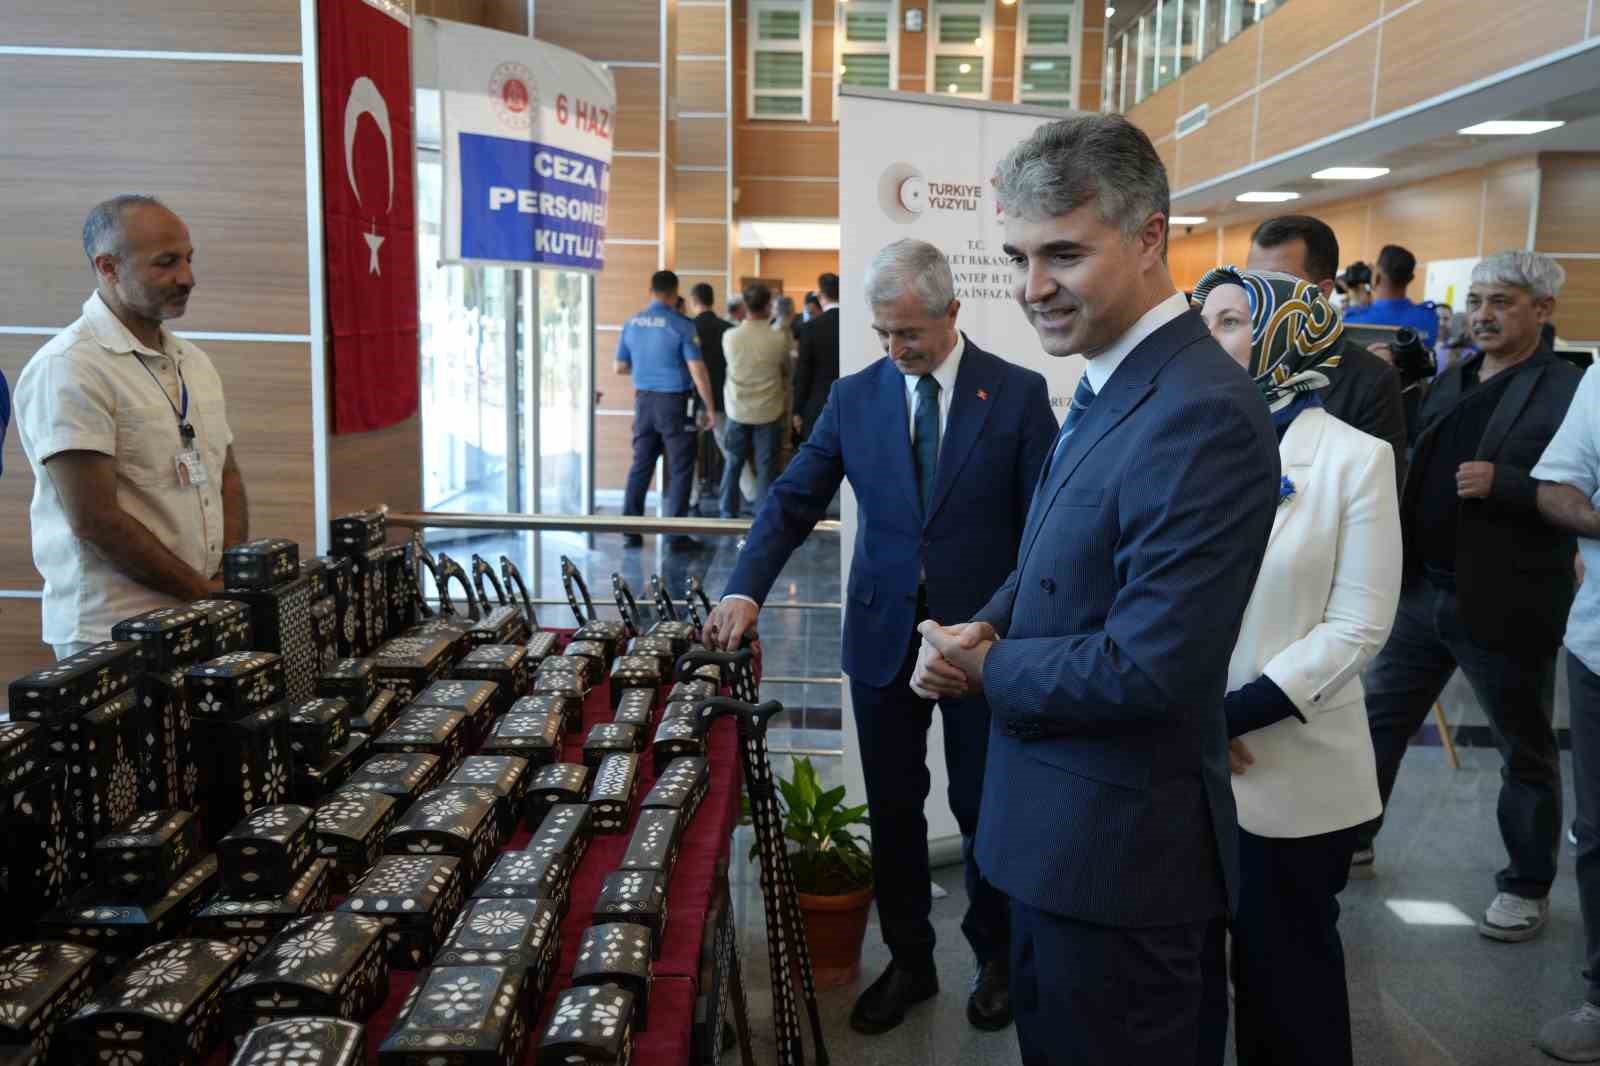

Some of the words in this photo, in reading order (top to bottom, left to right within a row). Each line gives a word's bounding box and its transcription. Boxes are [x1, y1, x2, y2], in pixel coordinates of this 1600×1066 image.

[556, 93, 568, 125] 6
[576, 98, 609, 138] HAZ
[534, 151, 597, 189] CEZA
[534, 229, 594, 258] KUTLU
[953, 271, 987, 283] ANTEP
[954, 287, 970, 298] ZA
